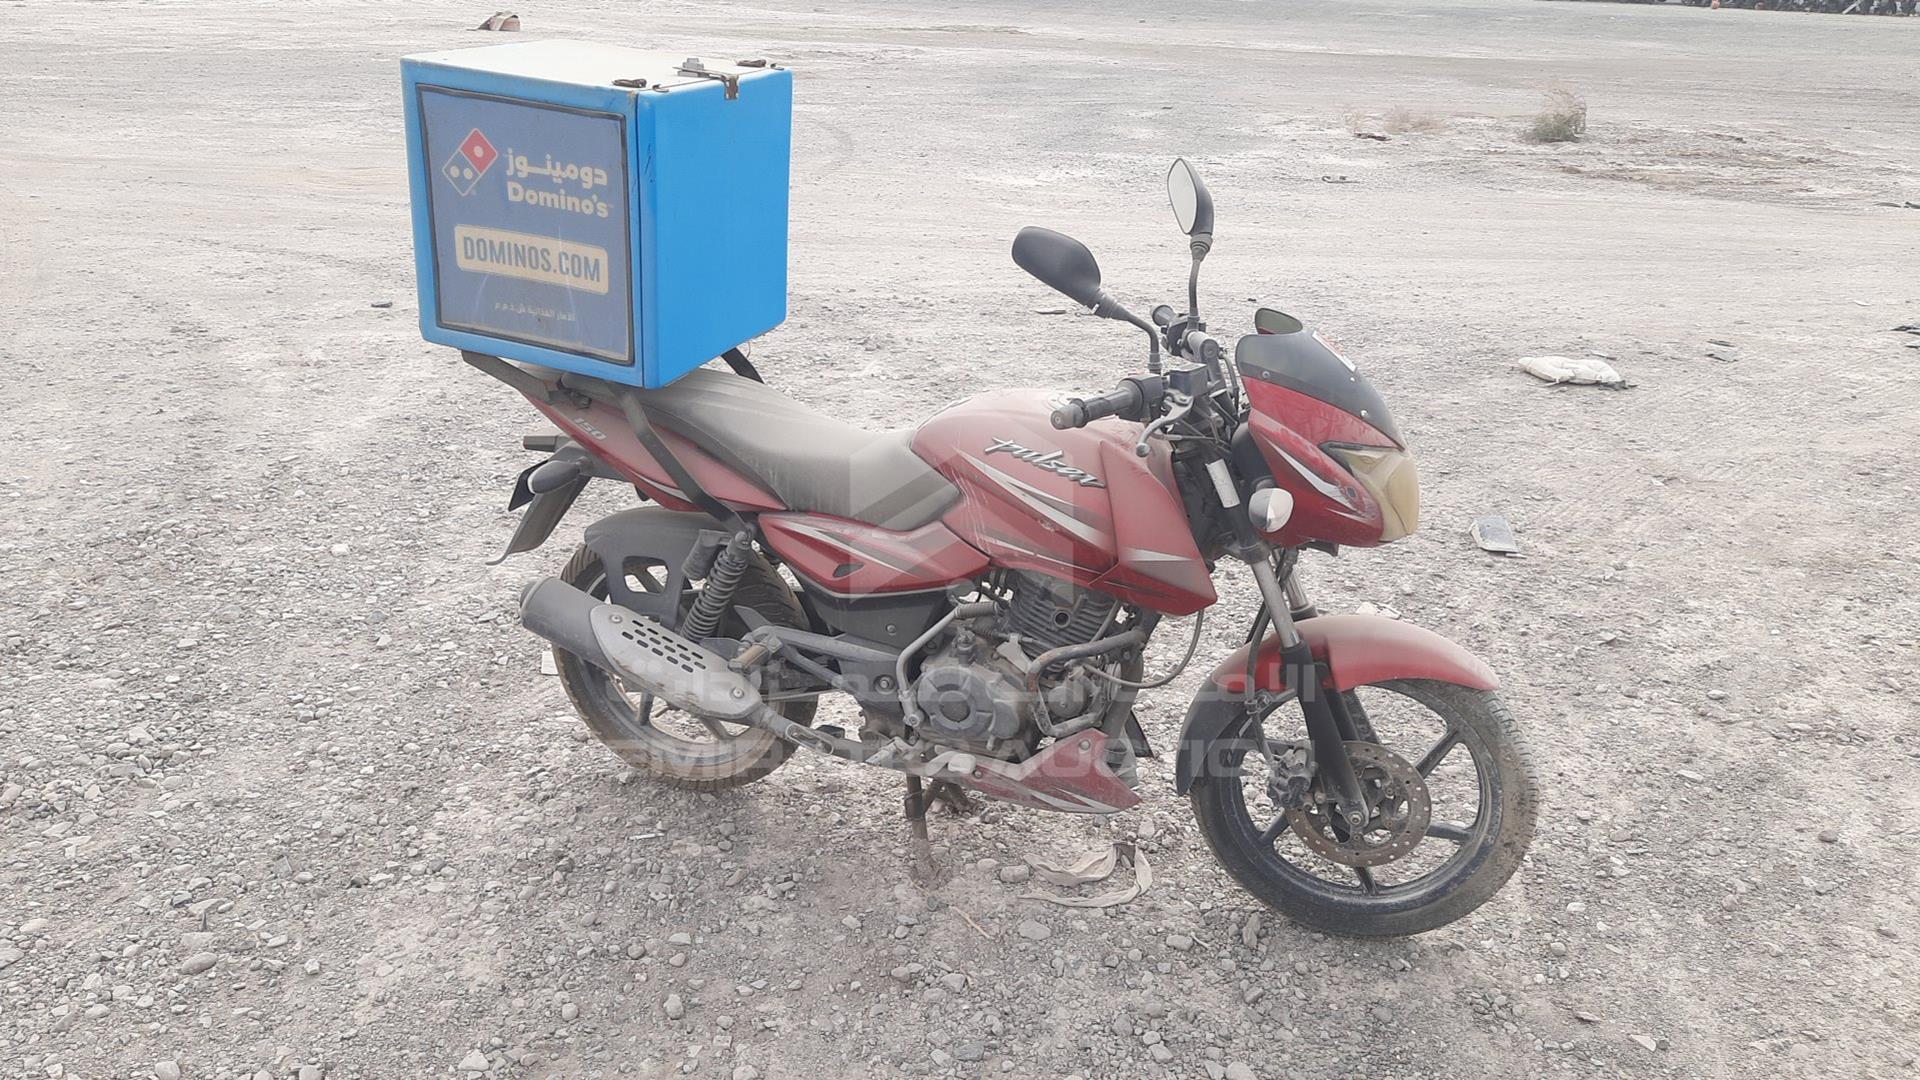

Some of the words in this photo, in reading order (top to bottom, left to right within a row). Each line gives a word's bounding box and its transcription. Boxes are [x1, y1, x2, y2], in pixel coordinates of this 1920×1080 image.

[507, 181, 609, 218] Domino's
[463, 236, 601, 282] DOMINOS.COM
[574, 418, 607, 440] 150
